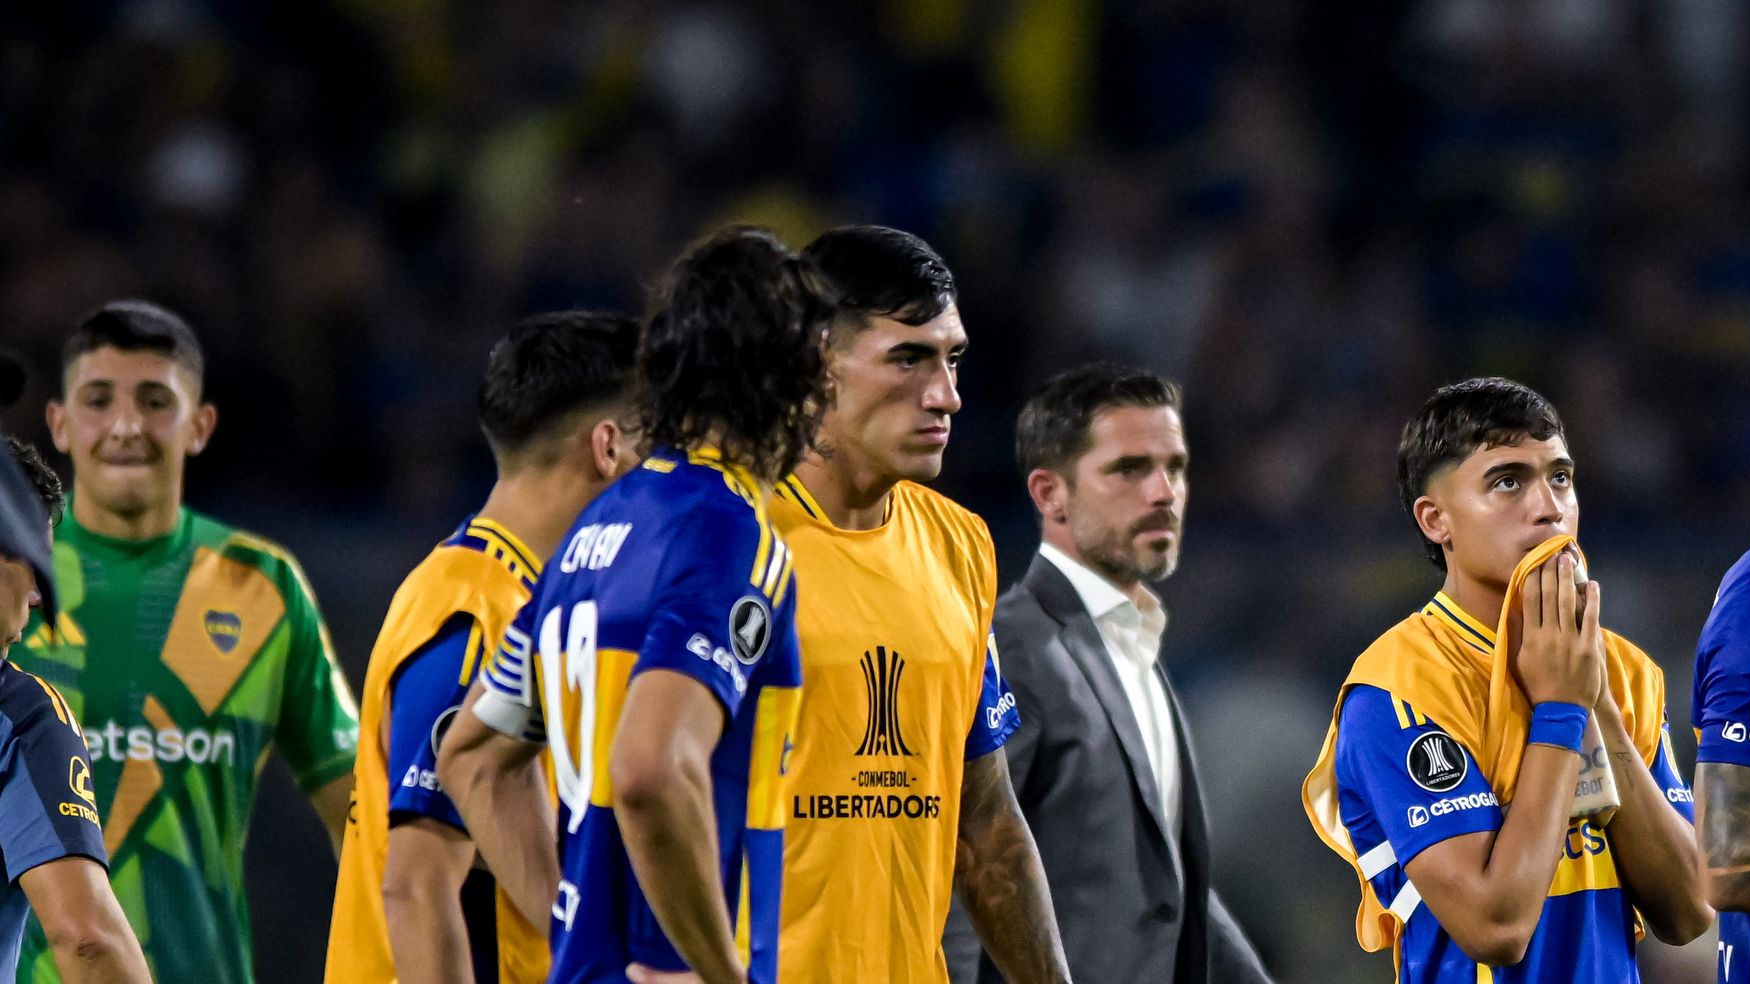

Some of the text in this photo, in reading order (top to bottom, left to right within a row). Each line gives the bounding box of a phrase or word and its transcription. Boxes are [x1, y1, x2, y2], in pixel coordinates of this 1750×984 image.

[83, 719, 236, 768] etsson
[858, 770, 910, 788] CONMEBOL
[58, 802, 100, 827] CETRO
[793, 794, 941, 819] LIBERTADORS
